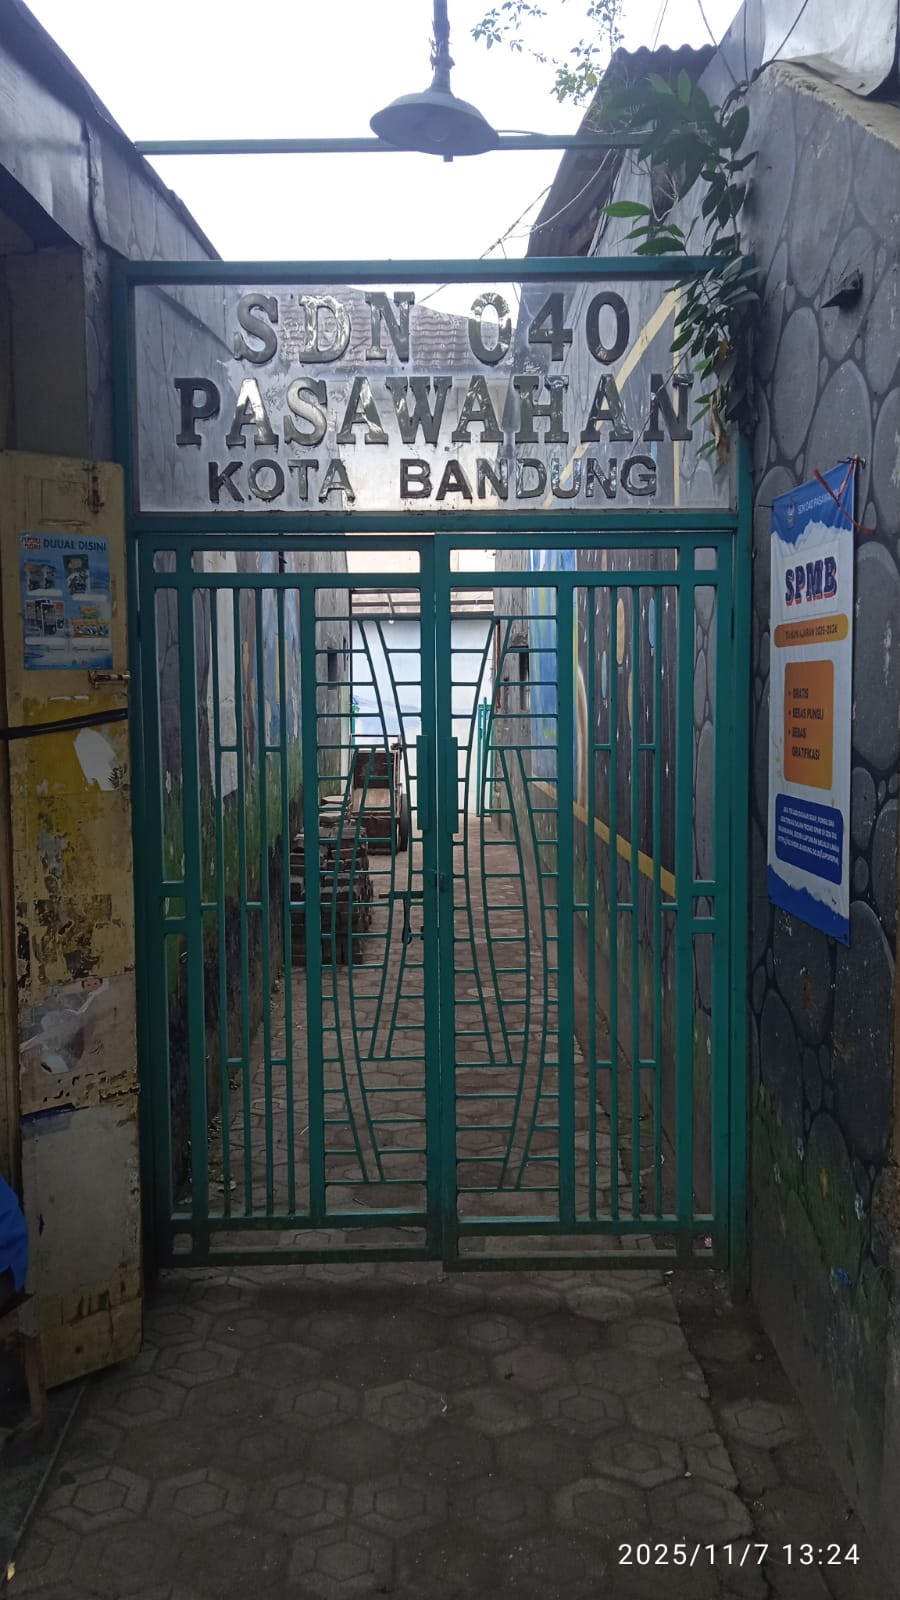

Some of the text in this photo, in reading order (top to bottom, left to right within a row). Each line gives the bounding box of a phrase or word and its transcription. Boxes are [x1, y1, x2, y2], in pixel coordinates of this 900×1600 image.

[234, 291, 630, 365] SDN 040
[173, 373, 694, 447] PASAWAHAN
[207, 456, 657, 503] KOTA BANDUNG
[79, 540, 106, 552] DISINI
[785, 556, 837, 607] SPMB
